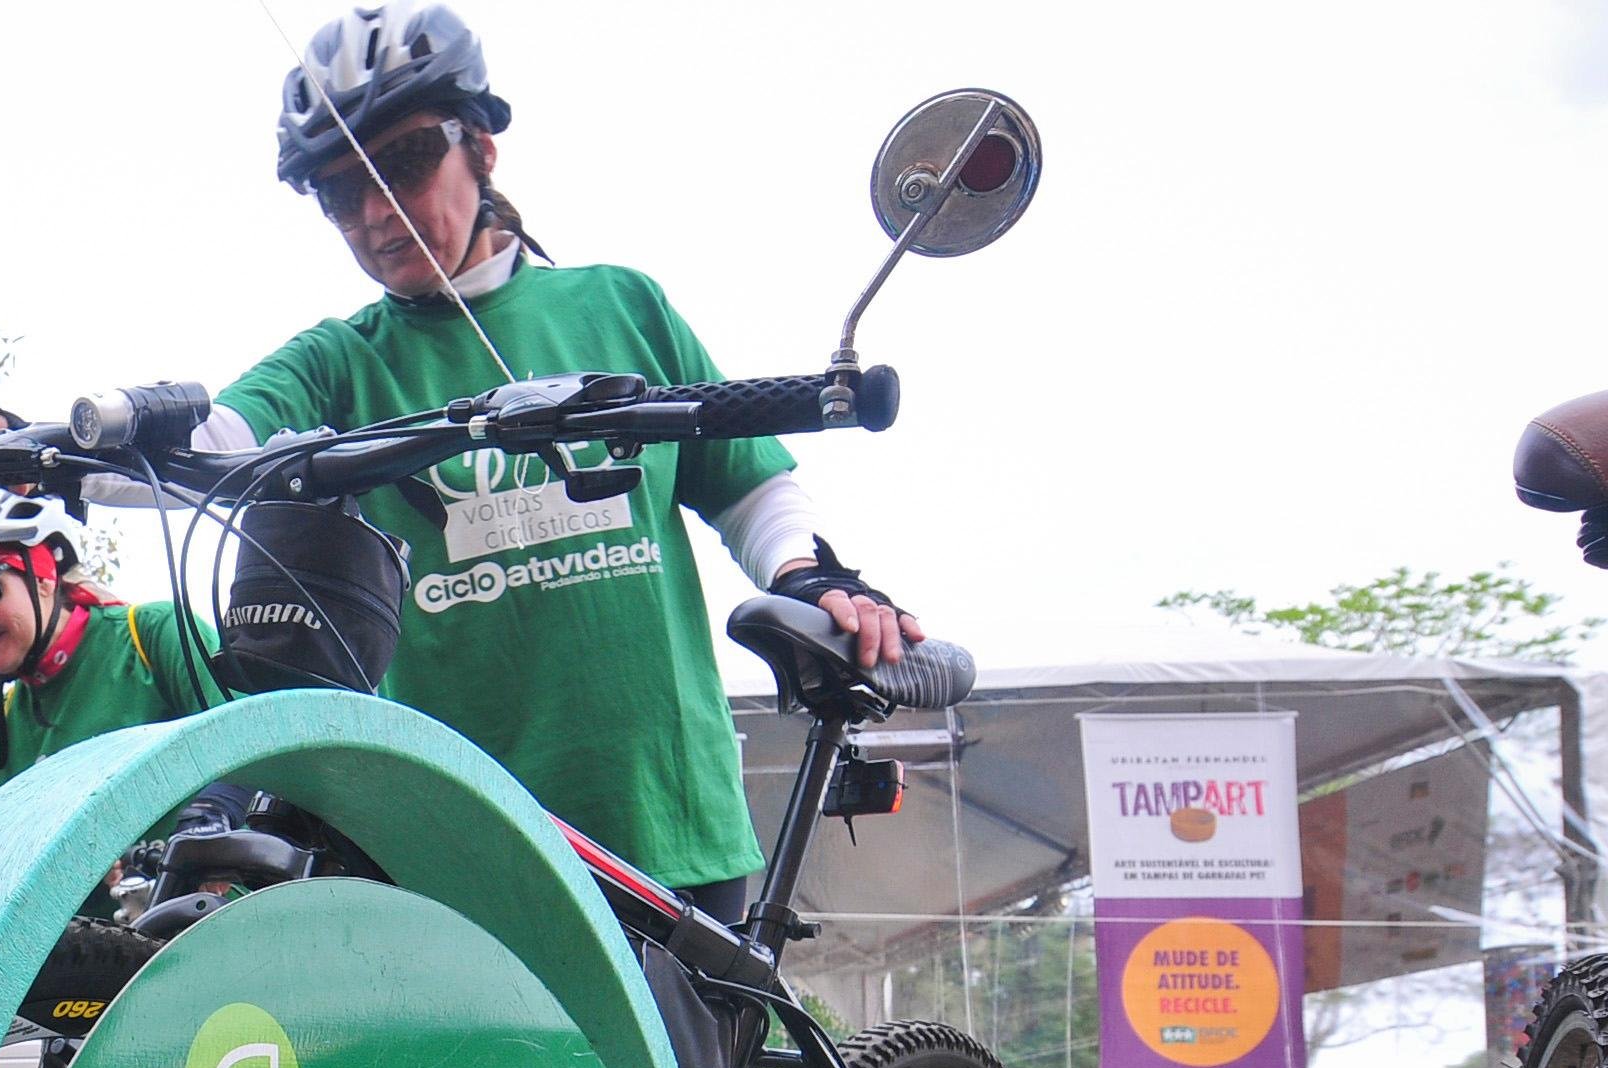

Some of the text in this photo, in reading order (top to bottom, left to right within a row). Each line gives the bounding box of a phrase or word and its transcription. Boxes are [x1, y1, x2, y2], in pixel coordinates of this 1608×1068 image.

[463, 494, 543, 524] voltas
[485, 507, 612, 550] ciclísticas
[223, 603, 322, 630] HIMAN
[1111, 779, 1269, 817] TAMPART
[1153, 950, 1240, 967] MUDE DE
[1158, 973, 1240, 990] ATITUDE.
[1159, 998, 1238, 1014] RECICLE.
